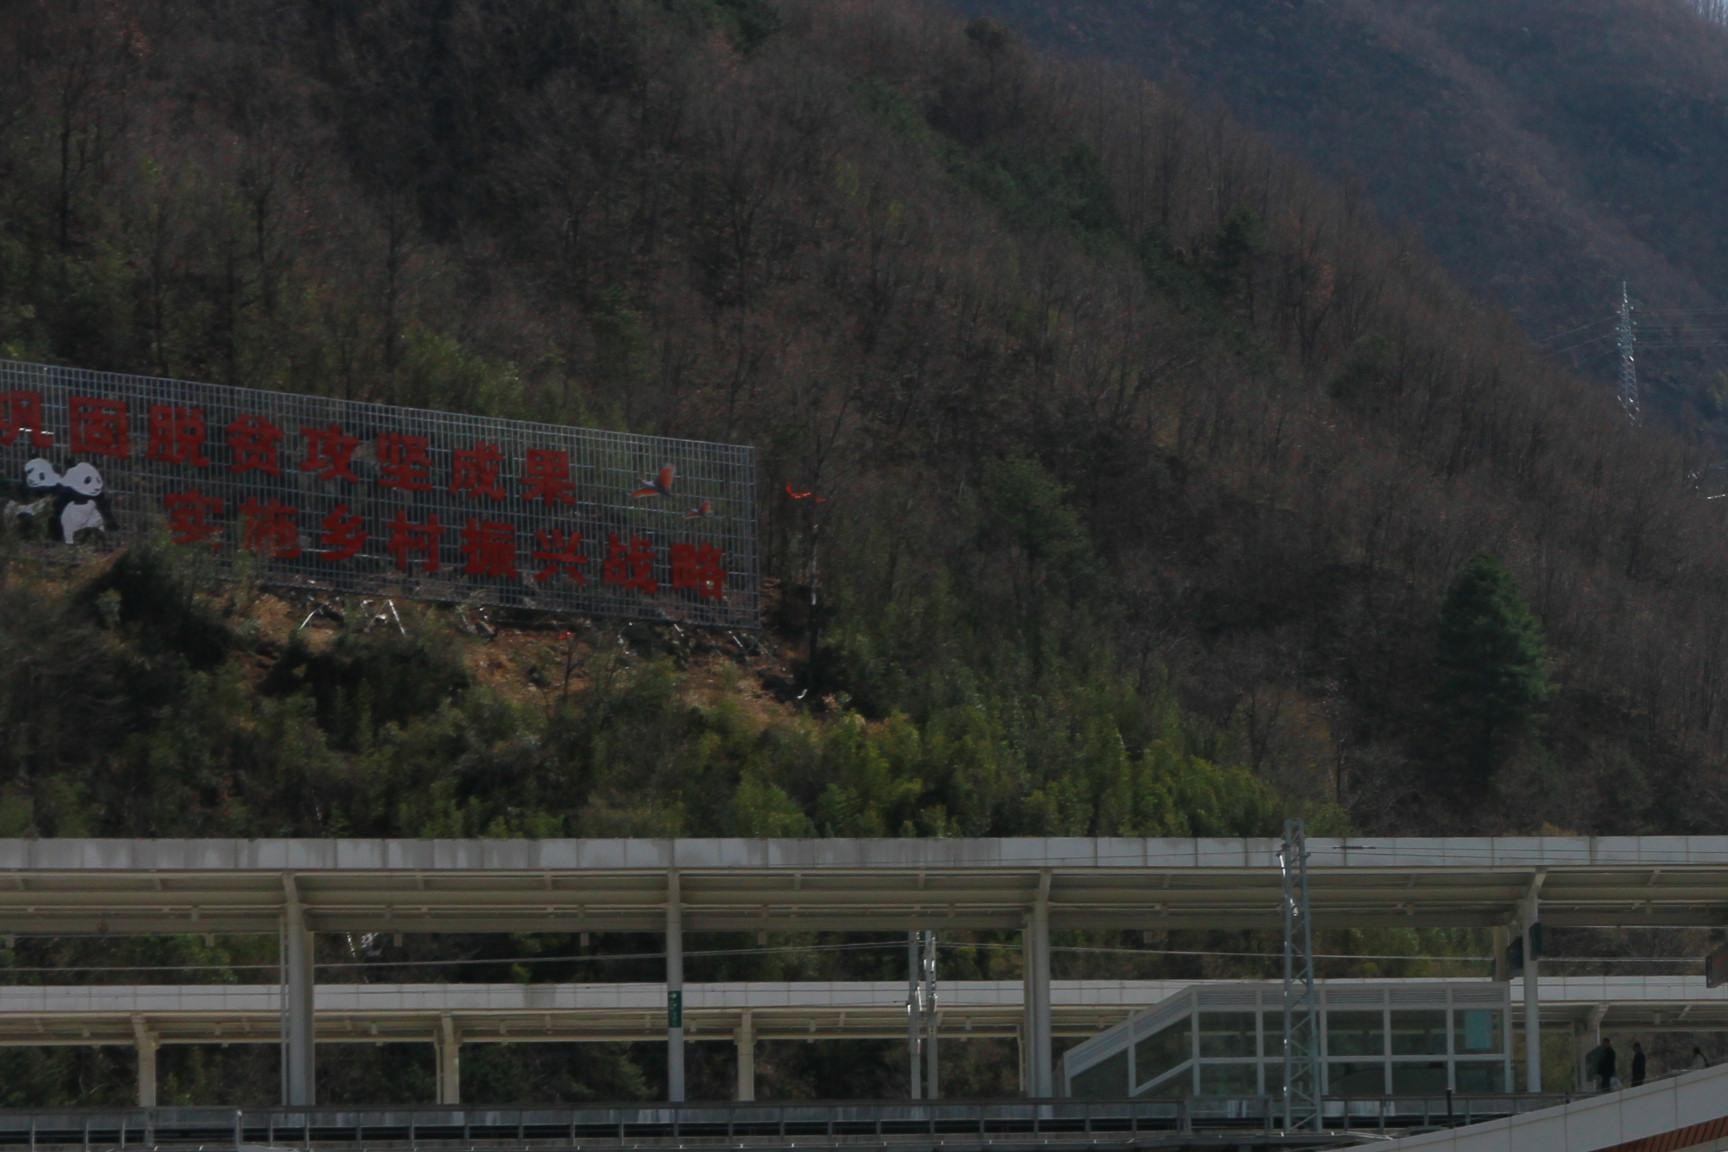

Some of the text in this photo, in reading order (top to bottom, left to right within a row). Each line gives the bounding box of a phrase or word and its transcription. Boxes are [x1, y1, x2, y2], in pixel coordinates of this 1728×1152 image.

[0, 390, 577, 508] 巩固脱贫攻坚成果
[163, 490, 728, 600] 实施乡村振兴战略
